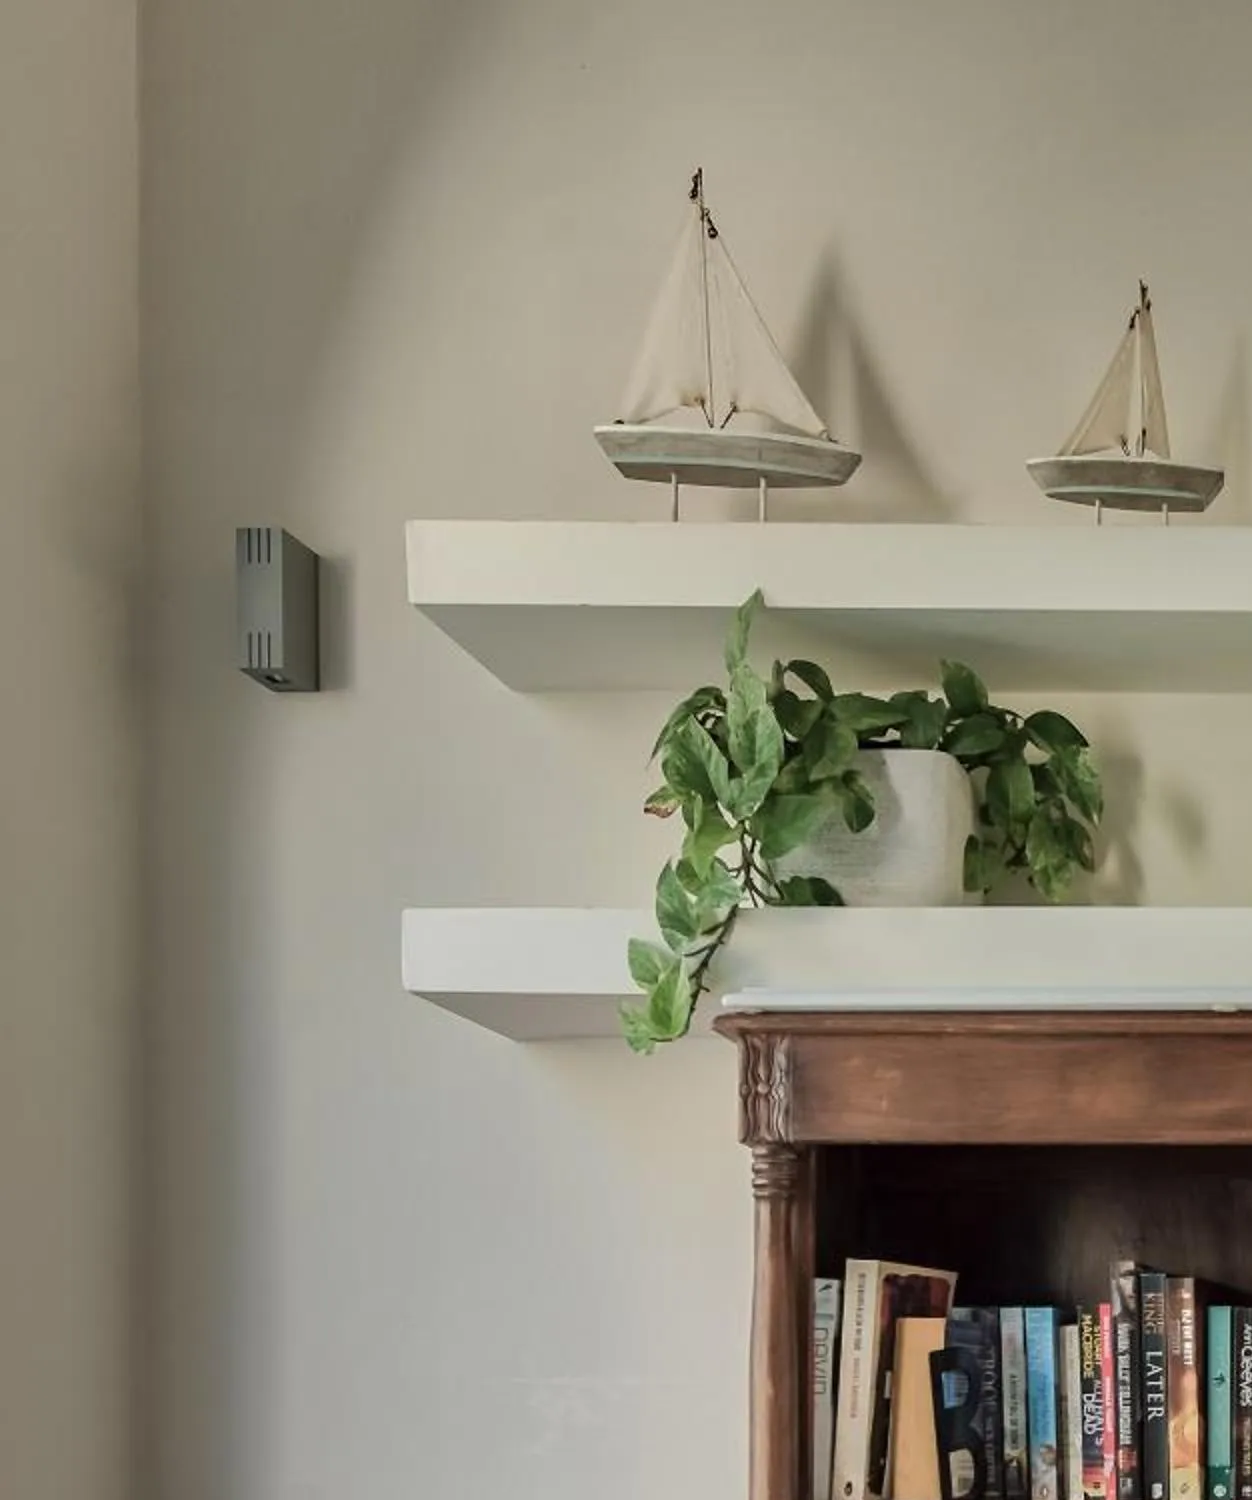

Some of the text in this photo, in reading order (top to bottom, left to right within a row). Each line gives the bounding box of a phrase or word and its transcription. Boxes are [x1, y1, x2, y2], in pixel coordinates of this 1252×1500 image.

[1145, 1292, 1159, 1335] KING
[1243, 1323, 1252, 1345] Ann
[1083, 1314, 1094, 1379] MACBRIDE
[1146, 1350, 1163, 1421] LATER
[1084, 1393, 1096, 1435] DEAD
